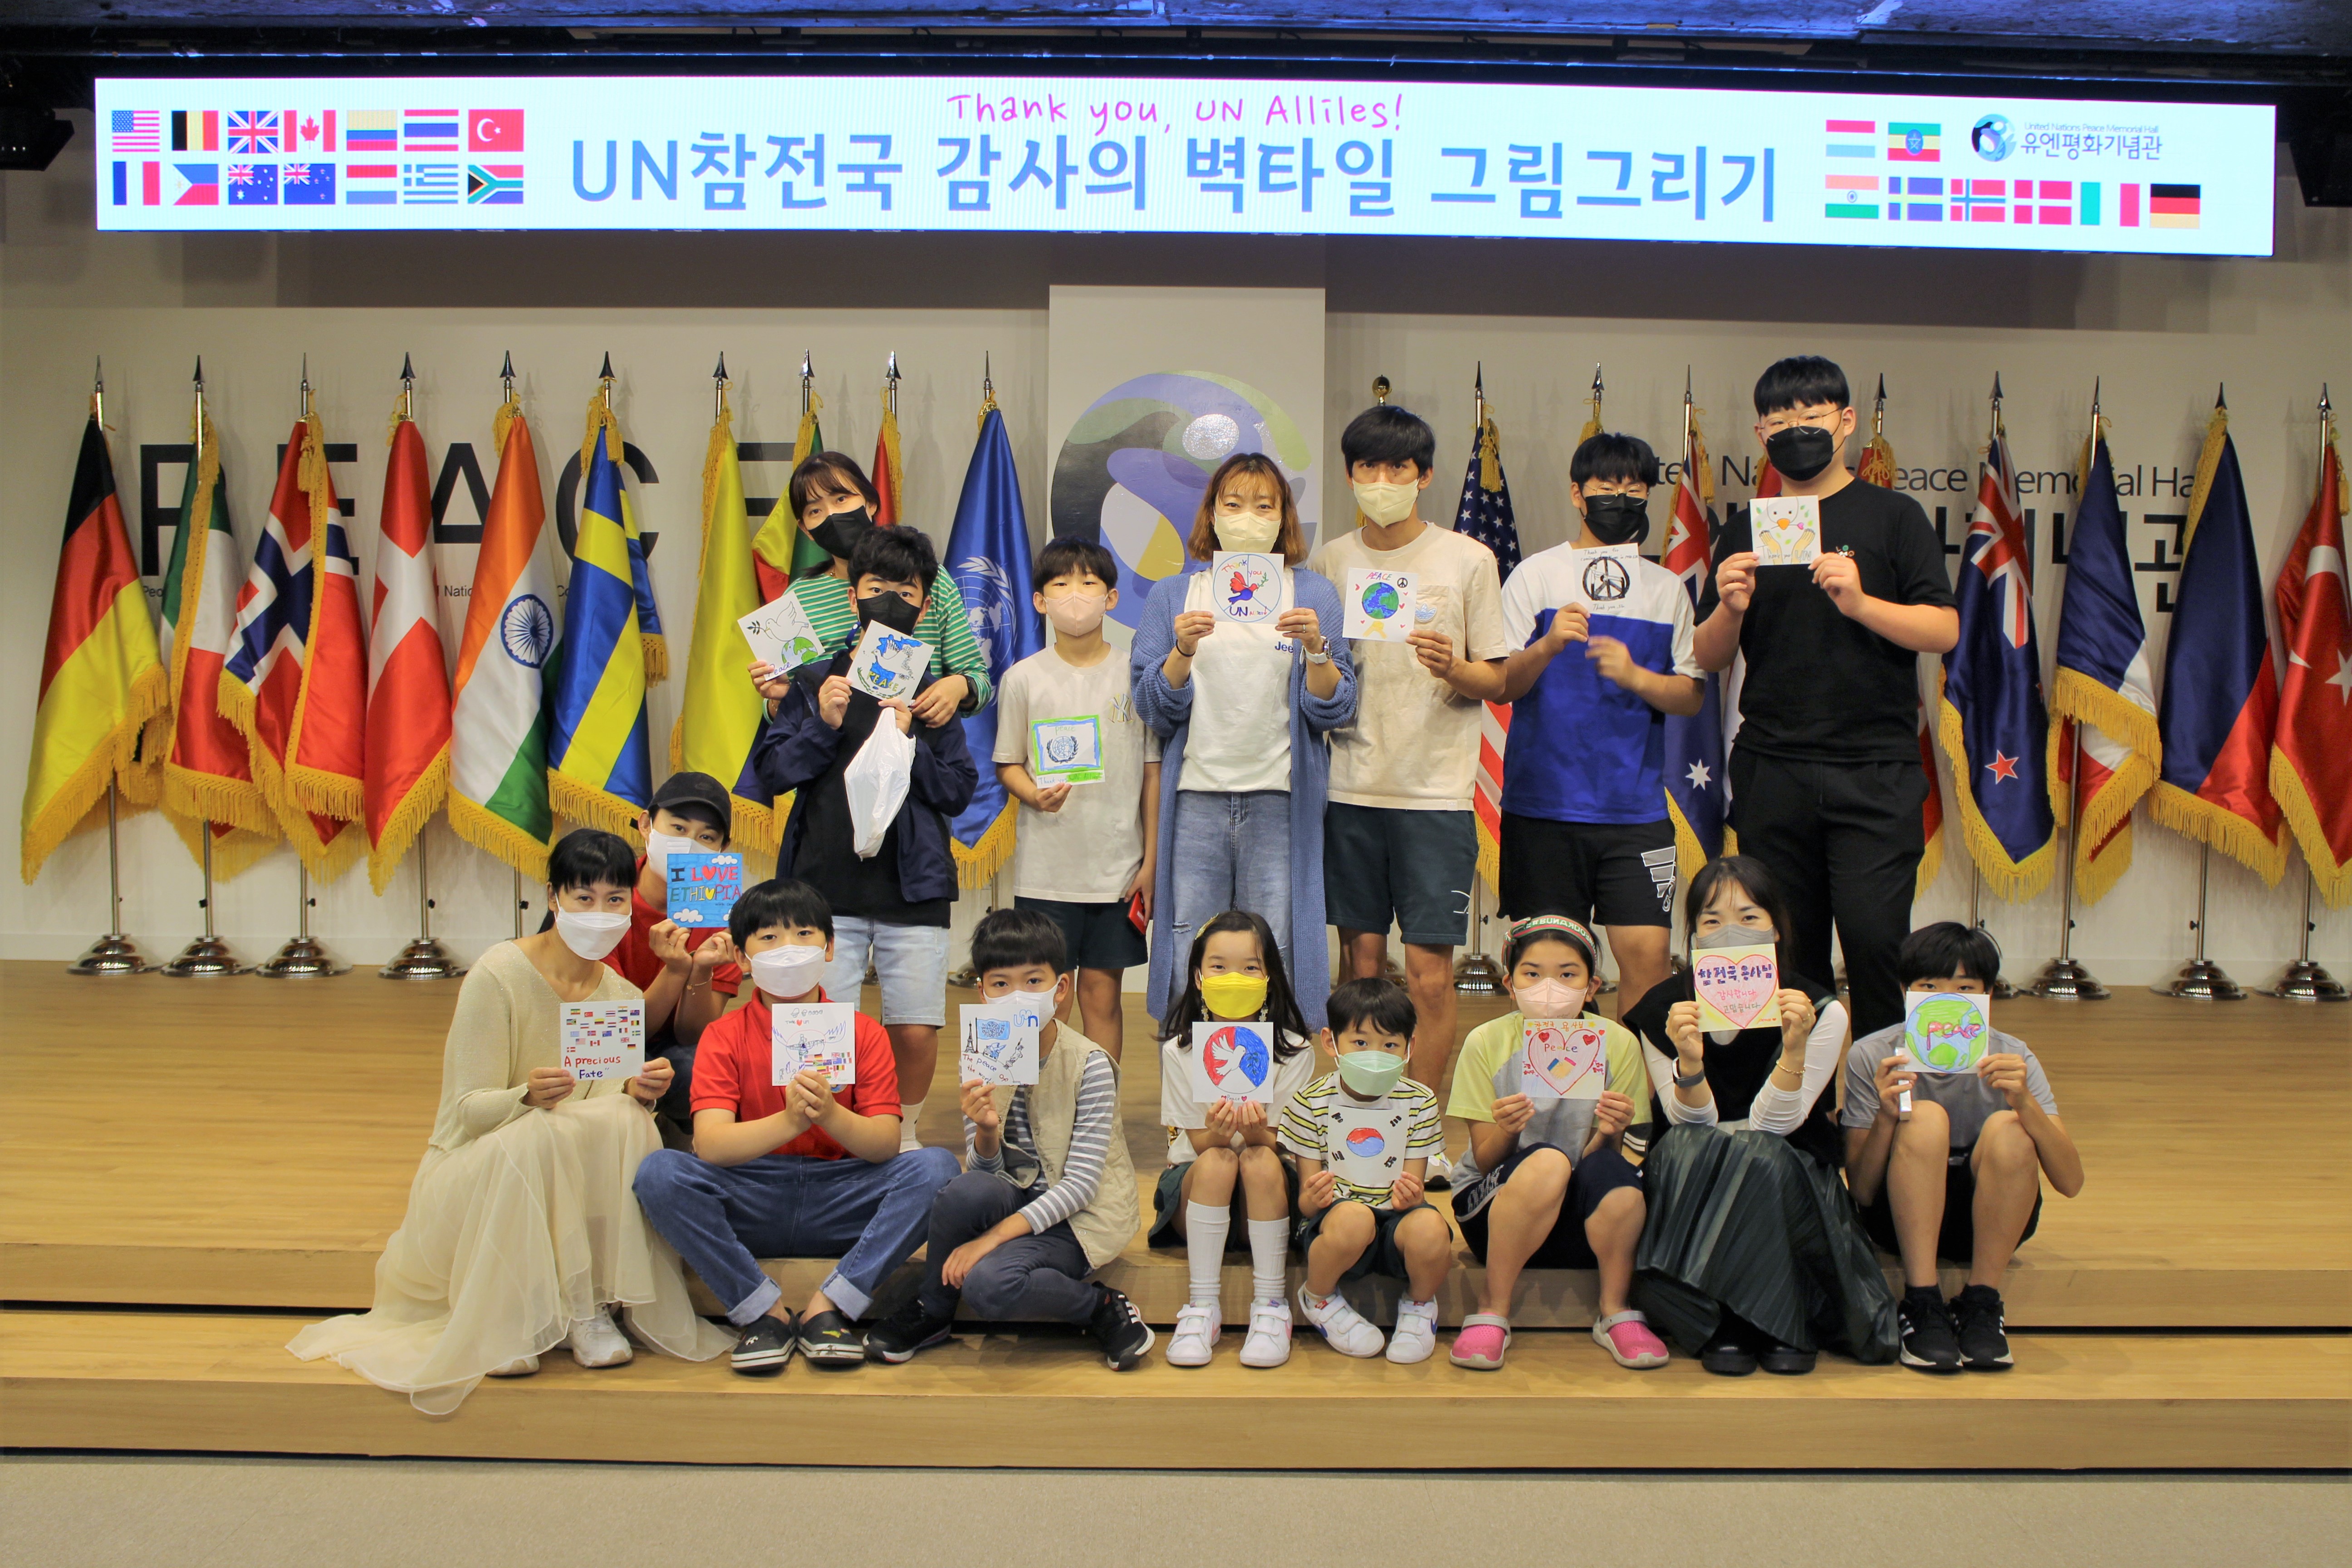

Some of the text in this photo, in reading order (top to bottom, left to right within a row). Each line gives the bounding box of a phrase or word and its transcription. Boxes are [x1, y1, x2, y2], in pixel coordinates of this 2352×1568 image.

[946, 93, 1403, 136] Thank you, UN Alliles!
[2024, 122, 2159, 133] United Nations Peace Memorial Hall
[2020, 132, 2163, 161] 유엔평화기념관
[572, 131, 1774, 222] UN참전국 감사의 벽타일 그림그리기
[1895, 467, 1967, 492] eace
[1795, 549, 1812, 561] UN
[1221, 559, 1247, 573] Thank
[1366, 572, 1392, 581] PEACE
[1229, 606, 1248, 617] UN
[1274, 641, 1294, 653] Jee
[867, 670, 900, 692] PEACE
[1054, 725, 1076, 735] peace
[671, 865, 739, 882] I LOVE
[670, 884, 742, 902] ETHIOPIA
[1544, 1043, 1578, 1052] Peace
[564, 1055, 621, 1068] A precious
[962, 1054, 973, 1063] The
[976, 1058, 997, 1072] peace
